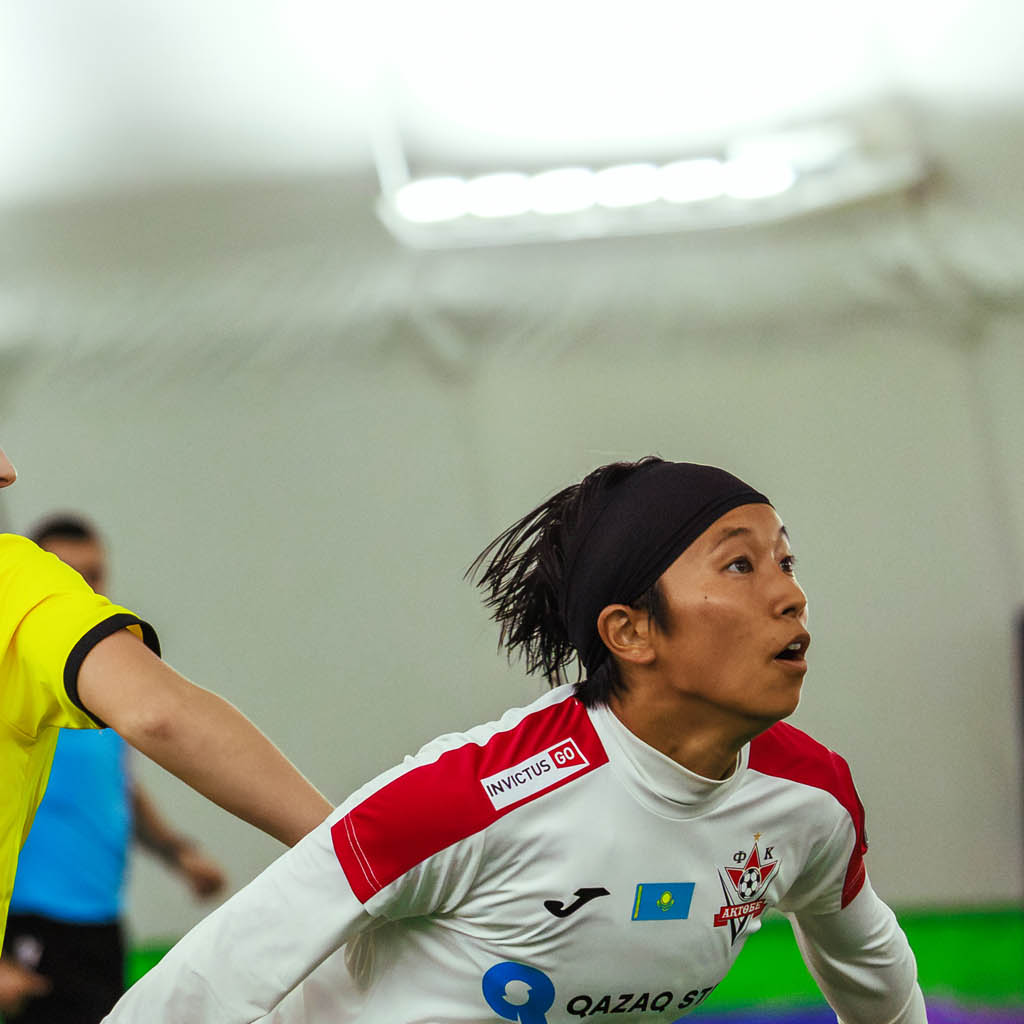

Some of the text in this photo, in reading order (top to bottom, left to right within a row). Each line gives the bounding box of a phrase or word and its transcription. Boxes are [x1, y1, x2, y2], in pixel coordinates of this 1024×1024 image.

[486, 746, 576, 798] INVICTUS GO
[566, 983, 720, 1018] QAZAQ ST
